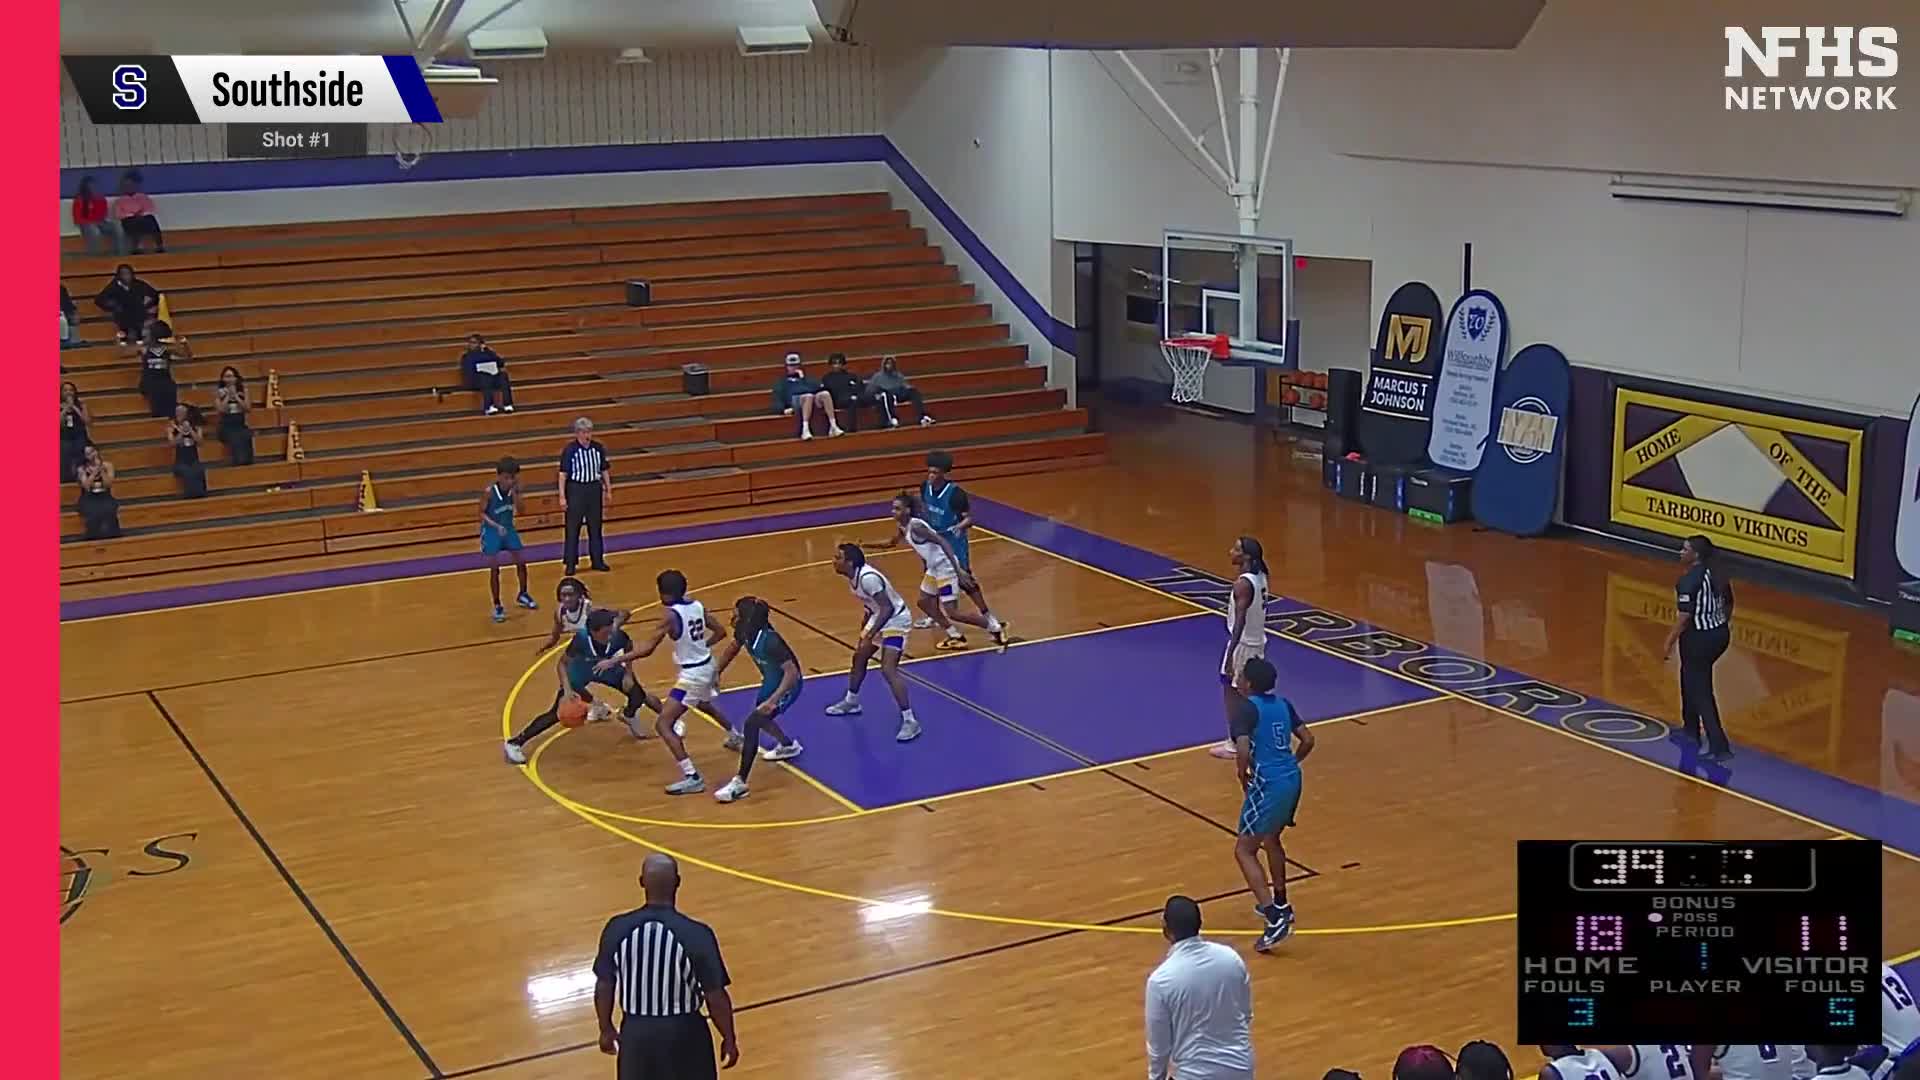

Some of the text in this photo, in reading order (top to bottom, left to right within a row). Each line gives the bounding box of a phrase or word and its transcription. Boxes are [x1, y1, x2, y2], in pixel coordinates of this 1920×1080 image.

[1384, 314, 1432, 363] MJ
[1370, 390, 1425, 412] JOHNSON
[1373, 376, 1419, 395] MARCUS
[1421, 383, 1429, 397] T
[1635, 428, 1682, 465] HOME
[1769, 442, 1832, 508] OF THE
[1646, 496, 1809, 549] TARBORO VIKINGS
[688, 617, 705, 643] 22
[1271, 721, 1289, 750] 5
